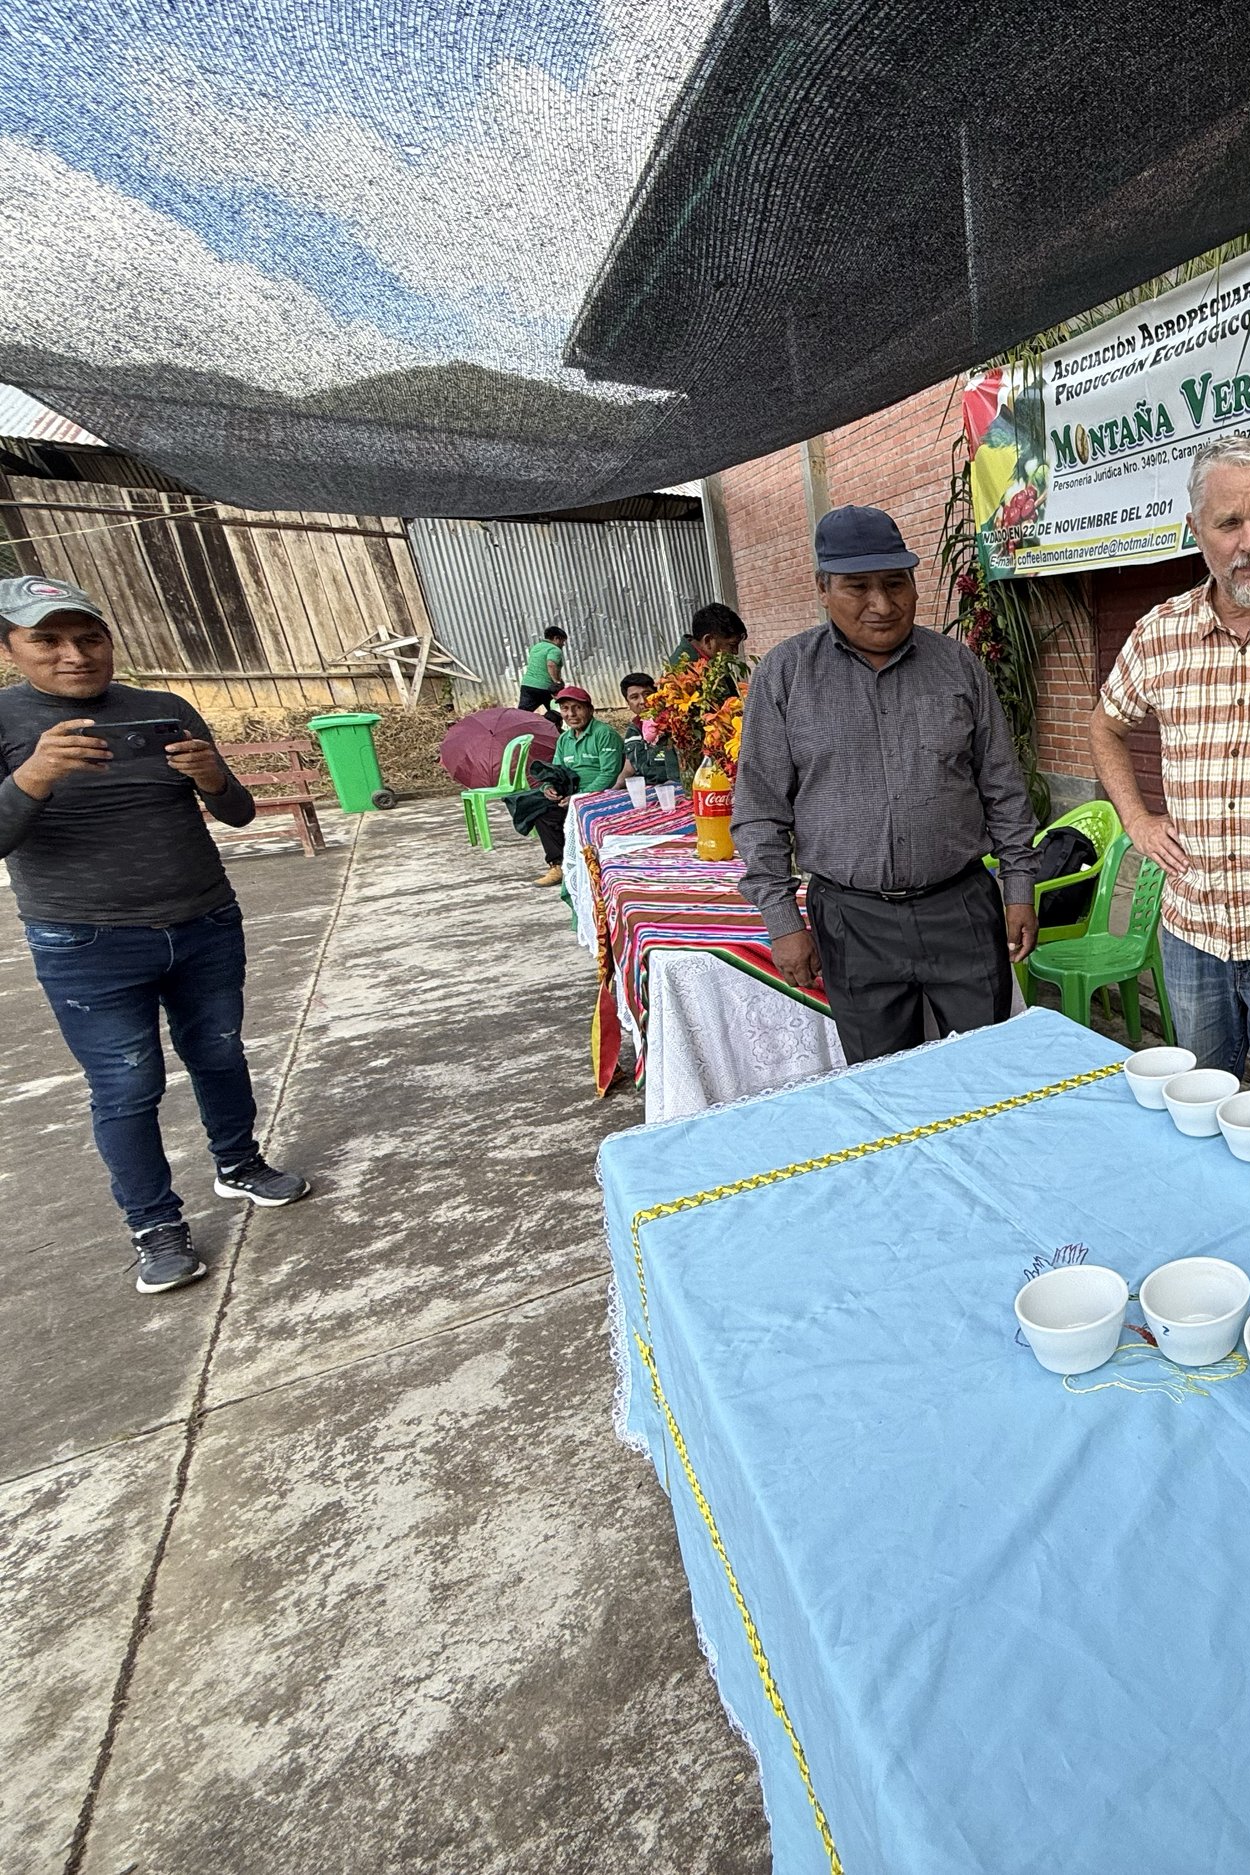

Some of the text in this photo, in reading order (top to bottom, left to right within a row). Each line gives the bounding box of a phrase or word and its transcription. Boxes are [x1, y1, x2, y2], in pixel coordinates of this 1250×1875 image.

[1051, 335, 1136, 382] ASOCIACIÓN
[1055, 356, 1149, 406] PRODUCCIÓN
[1050, 400, 1175, 472] MONTAÑA
[1123, 461, 1140, 474] Nro.
[1008, 526, 1020, 540] EN
[1022, 524, 1035, 538] 22
[1037, 522, 1052, 536] DE
[1055, 510, 1118, 534] NOVIEMBRE
[1120, 505, 1142, 523] DEL
[1146, 498, 1174, 518] 2001
